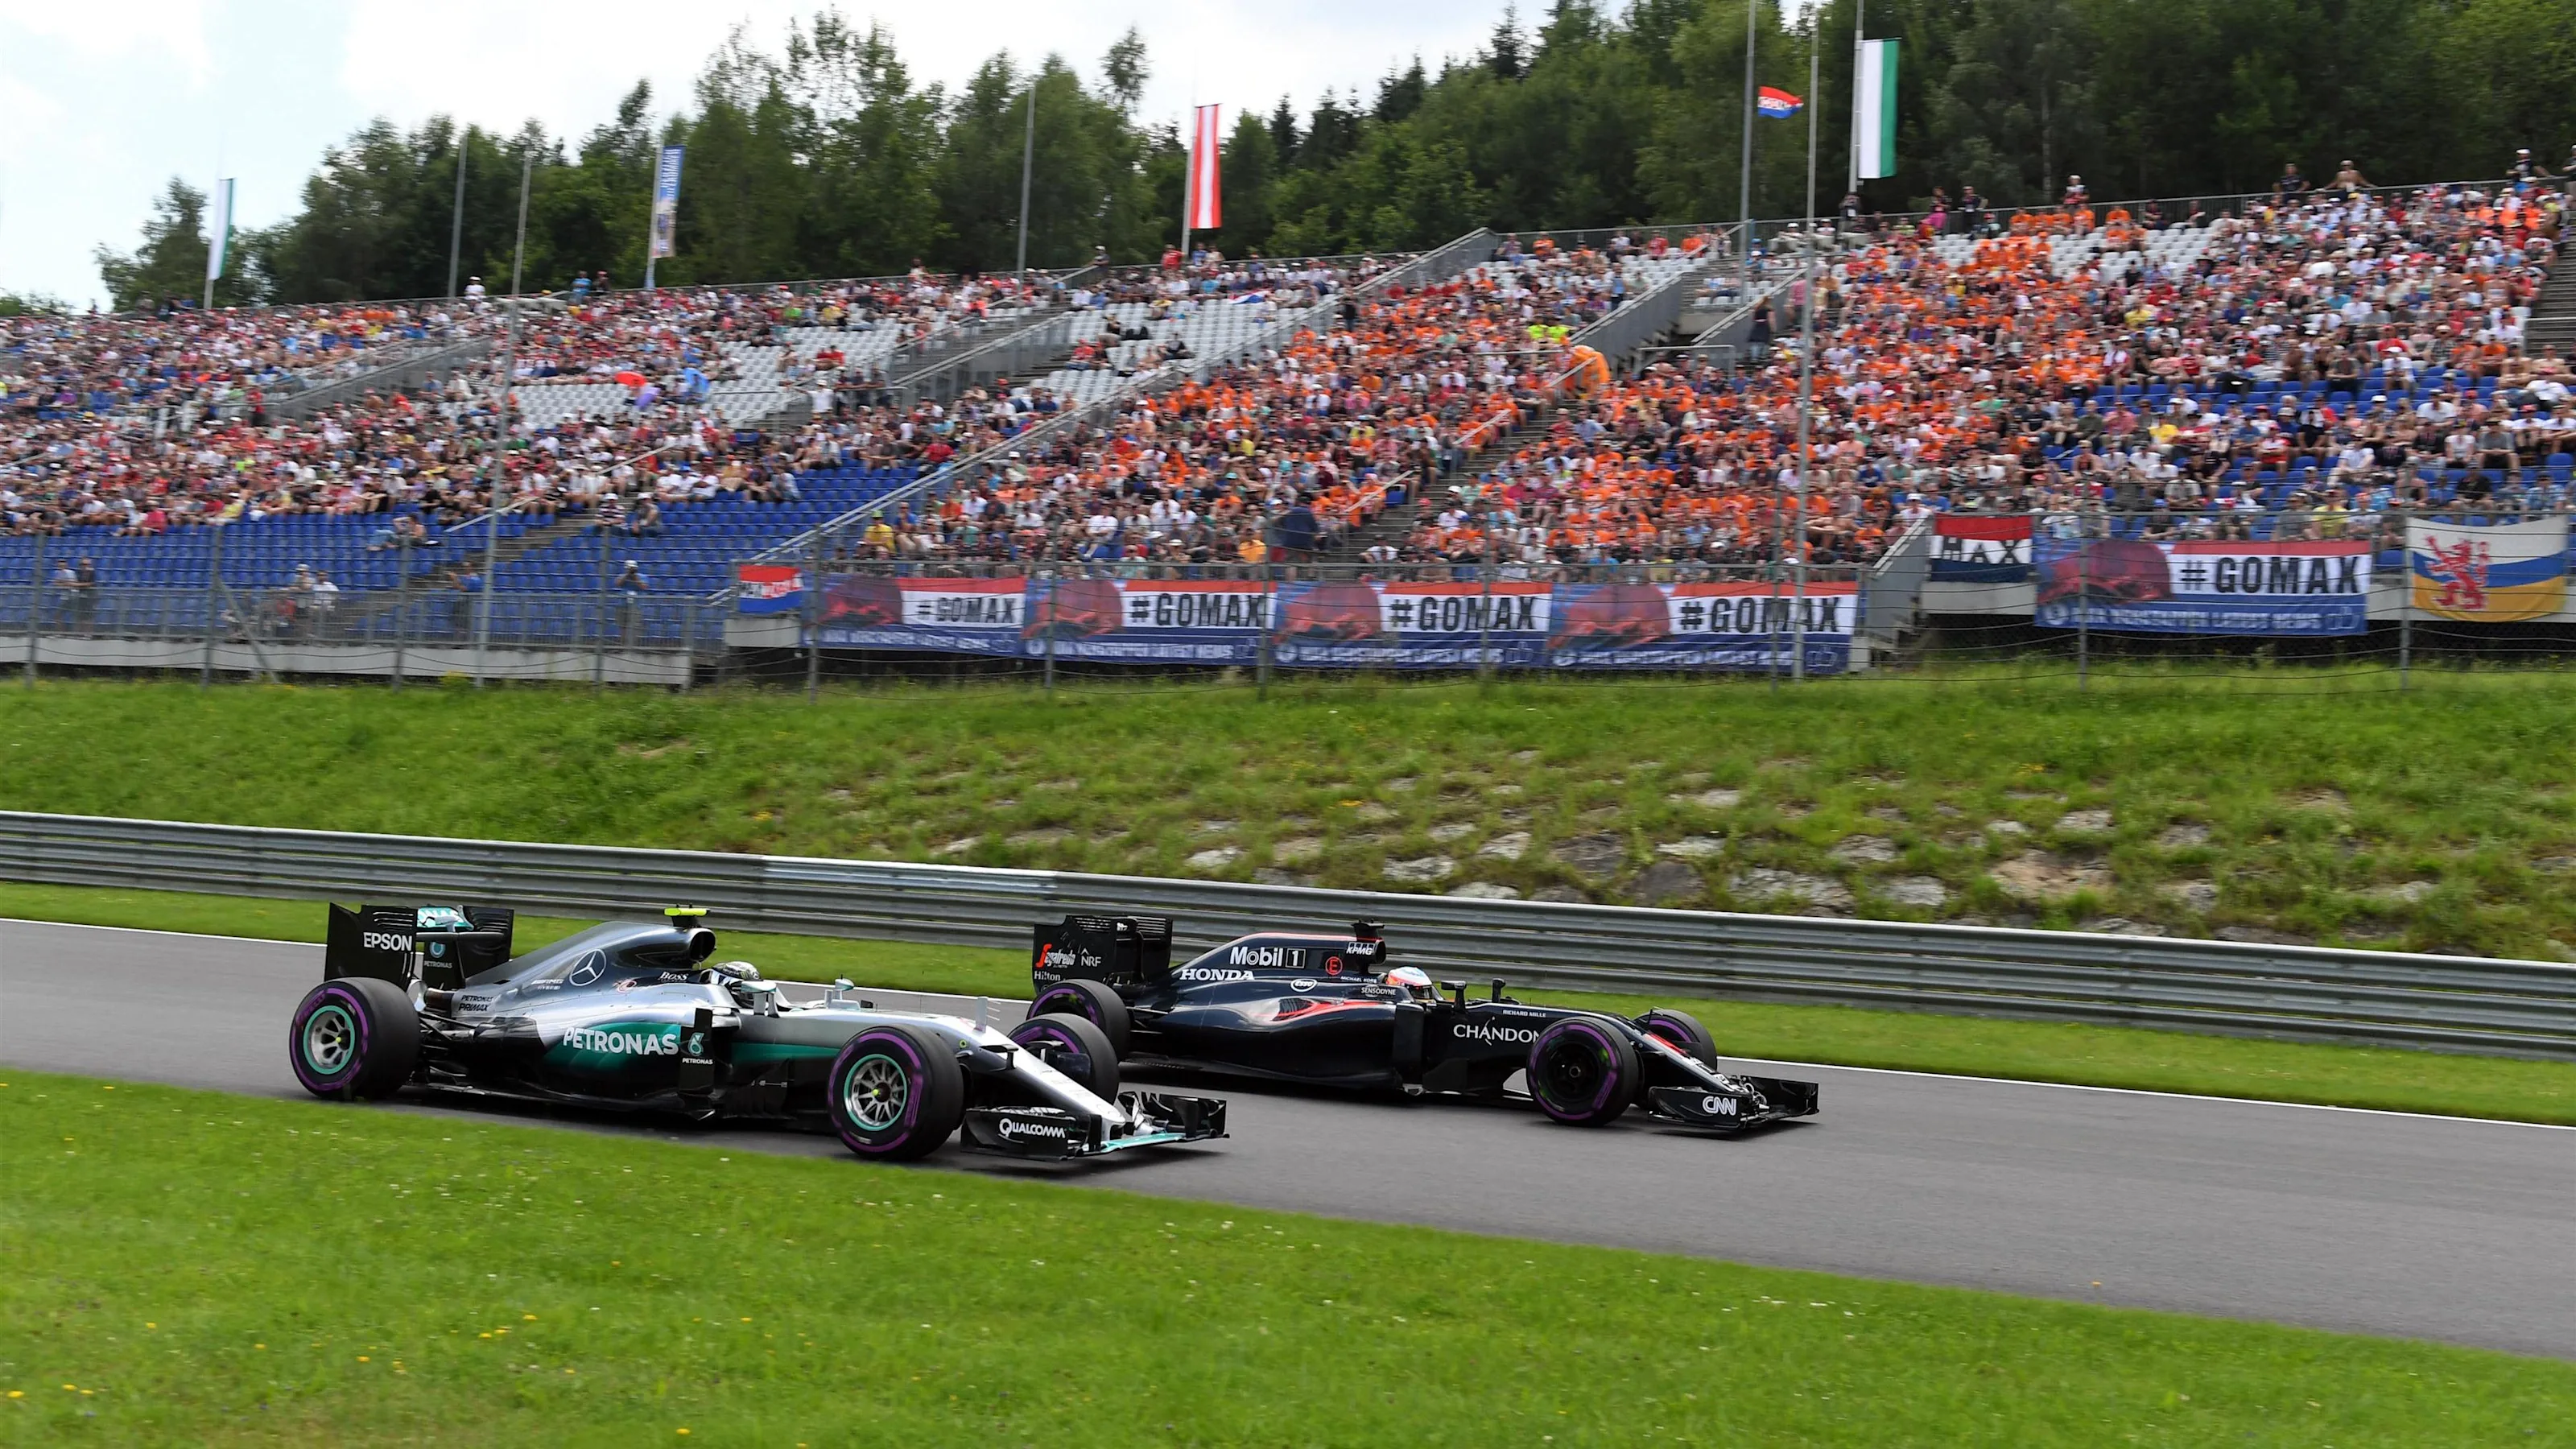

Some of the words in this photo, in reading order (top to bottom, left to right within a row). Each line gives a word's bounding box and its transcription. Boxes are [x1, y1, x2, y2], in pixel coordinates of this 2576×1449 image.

[2180, 556, 2359, 594] #GOMAX
[916, 597, 1016, 623] #GOMAX
[1131, 592, 1262, 627] #GOMAX
[1389, 596, 1536, 631] #GOMAX
[1680, 597, 1840, 634] #GOMAX
[363, 932, 412, 952] EPSON
[1346, 946, 1375, 956] KPMG
[423, 960, 453, 969] PETRONAS
[1035, 943, 1076, 968] Segafredo
[1080, 956, 1102, 968] NRF
[1229, 946, 1284, 968] Mobil
[1034, 970, 1061, 981] Hilton
[1179, 968, 1255, 981] HONDA
[1329, 959, 1339, 973] E
[1360, 987, 1397, 996] SENSODYNE
[458, 1003, 491, 1012] PRIMAX
[563, 1027, 679, 1055] PETRONAS
[682, 1057, 714, 1065] PETRONAS
[1703, 1096, 1737, 1116] CNN
[998, 1117, 1066, 1139] QUALCOMM
